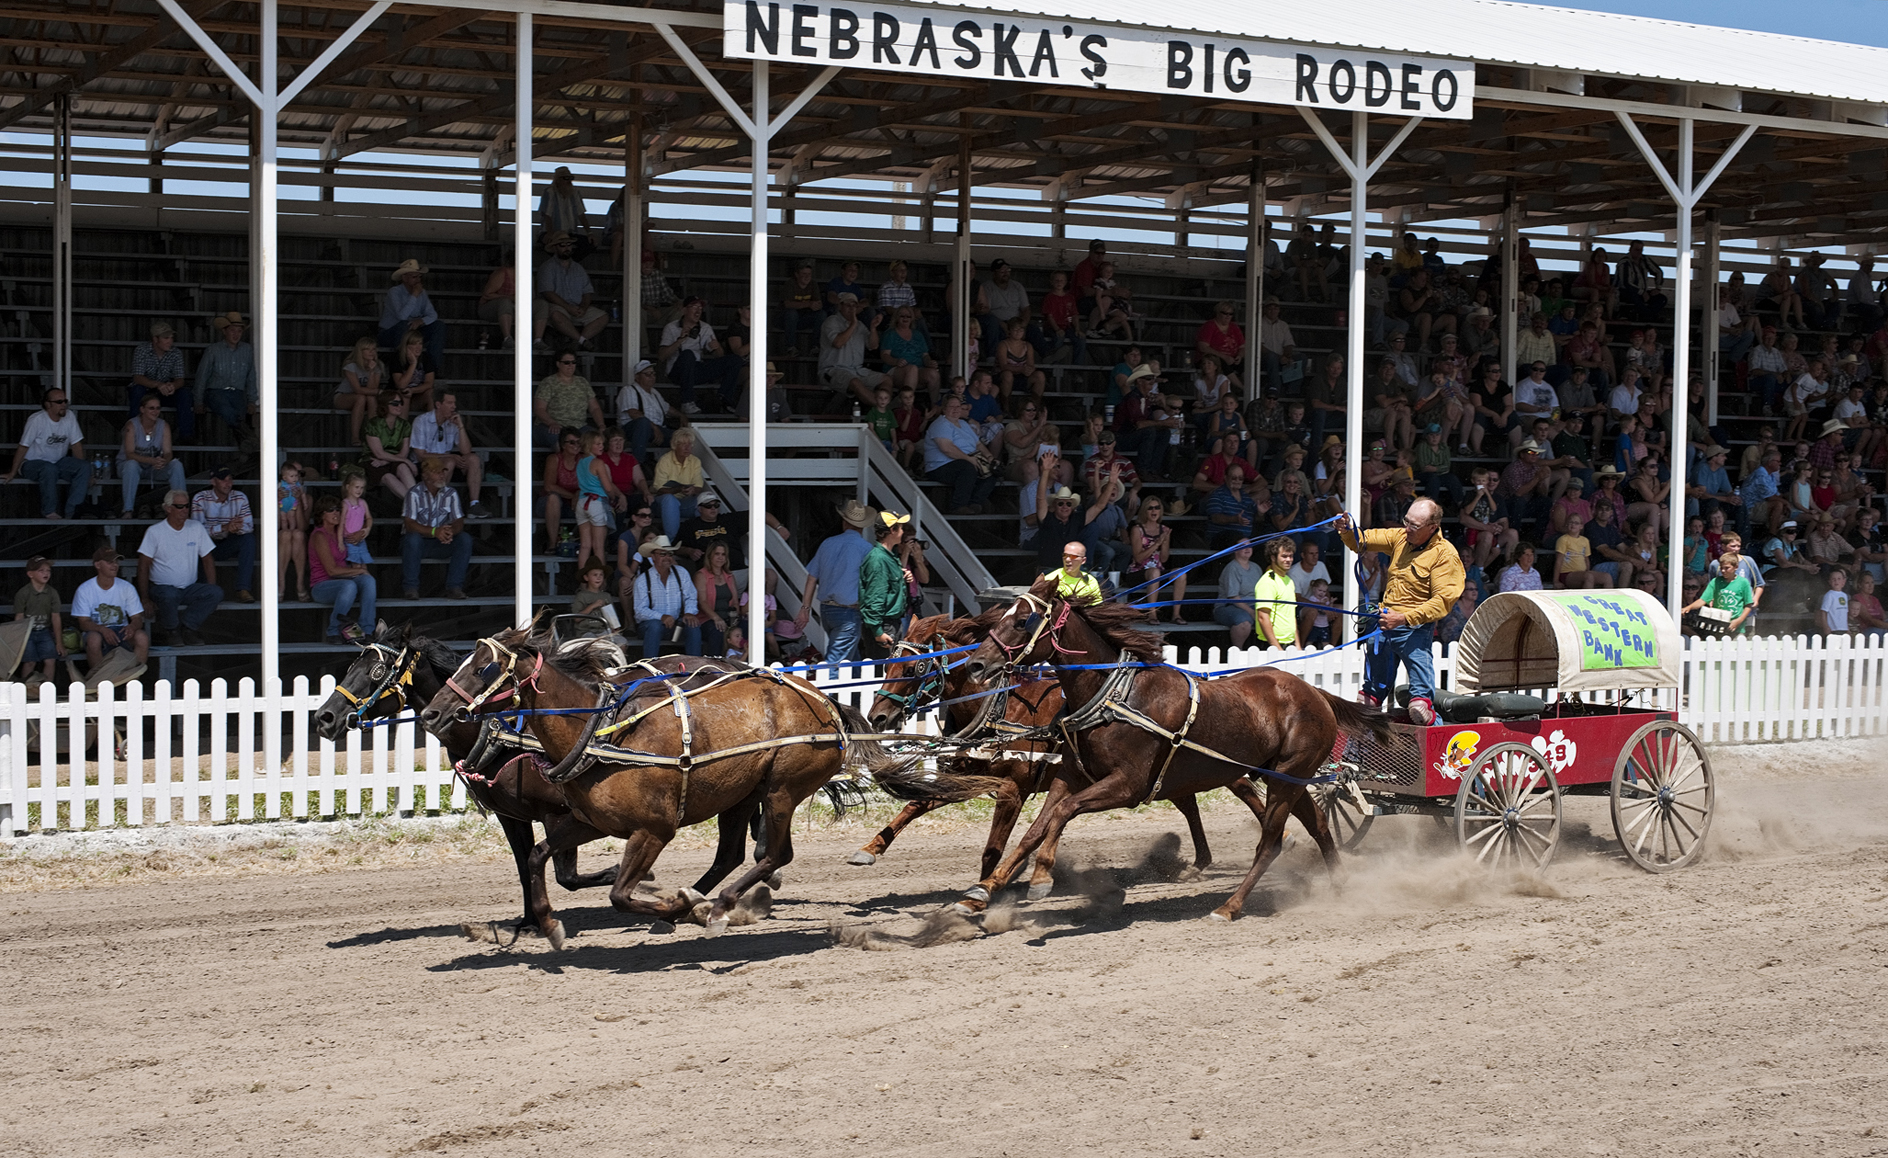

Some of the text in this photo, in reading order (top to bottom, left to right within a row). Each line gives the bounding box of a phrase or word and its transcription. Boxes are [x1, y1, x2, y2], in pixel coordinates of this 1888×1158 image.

[745, 0, 1457, 112] NEBRASKA'S BIG RODEO
[1583, 595, 1647, 625] GREAT
[1567, 604, 1653, 657] WESTERN
[1583, 630, 1623, 666] BANK
[1429, 731, 1446, 752] 07
